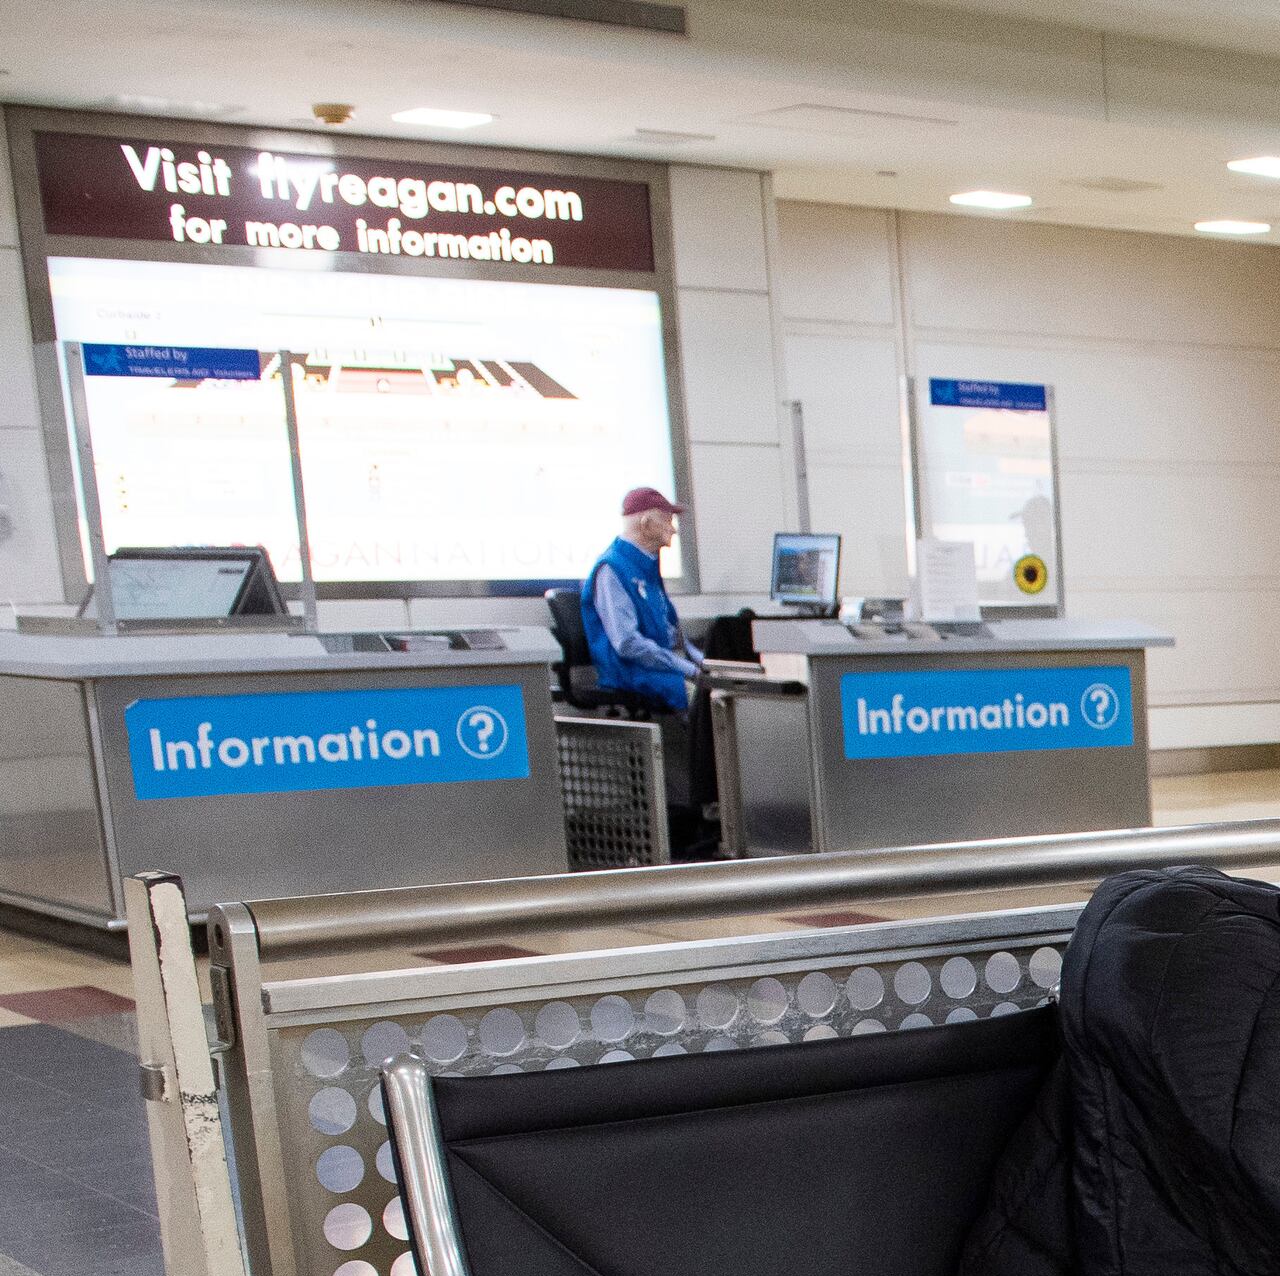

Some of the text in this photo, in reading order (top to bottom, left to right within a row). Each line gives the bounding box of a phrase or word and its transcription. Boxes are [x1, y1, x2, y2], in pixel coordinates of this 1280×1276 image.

[120, 144, 583, 220] Visit flyreagan.com
[169, 204, 555, 265] for more information
[124, 346, 188, 363] Staffed by
[858, 693, 1069, 734] Information
[150, 720, 440, 771] Information
